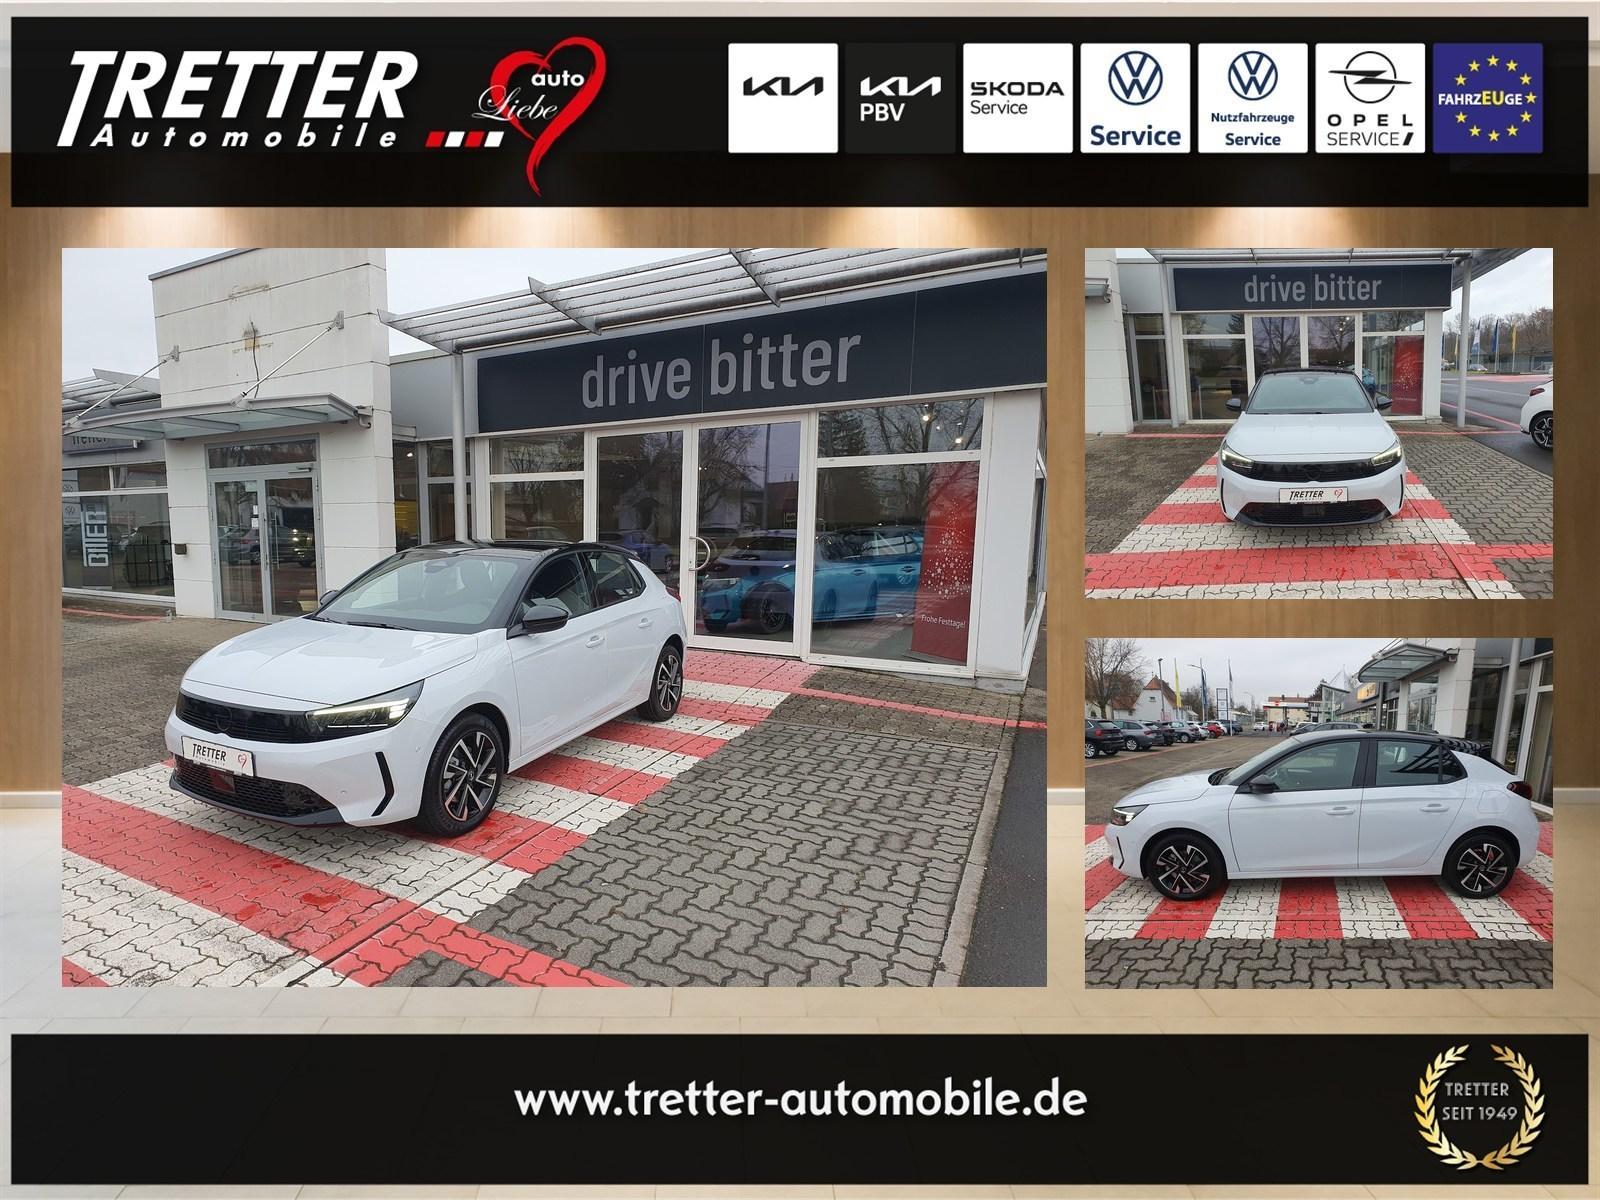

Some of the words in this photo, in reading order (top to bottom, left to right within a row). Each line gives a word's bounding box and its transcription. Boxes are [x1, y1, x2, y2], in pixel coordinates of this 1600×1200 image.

[1244, 274, 1306, 302] drive
[1314, 273, 1382, 302] bitter
[581, 350, 692, 409] drive
[710, 332, 862, 396] bitter
[1289, 490, 1325, 501] TRETTER
[921, 614, 938, 624] Frohe
[192, 743, 227, 761] TRETTER
